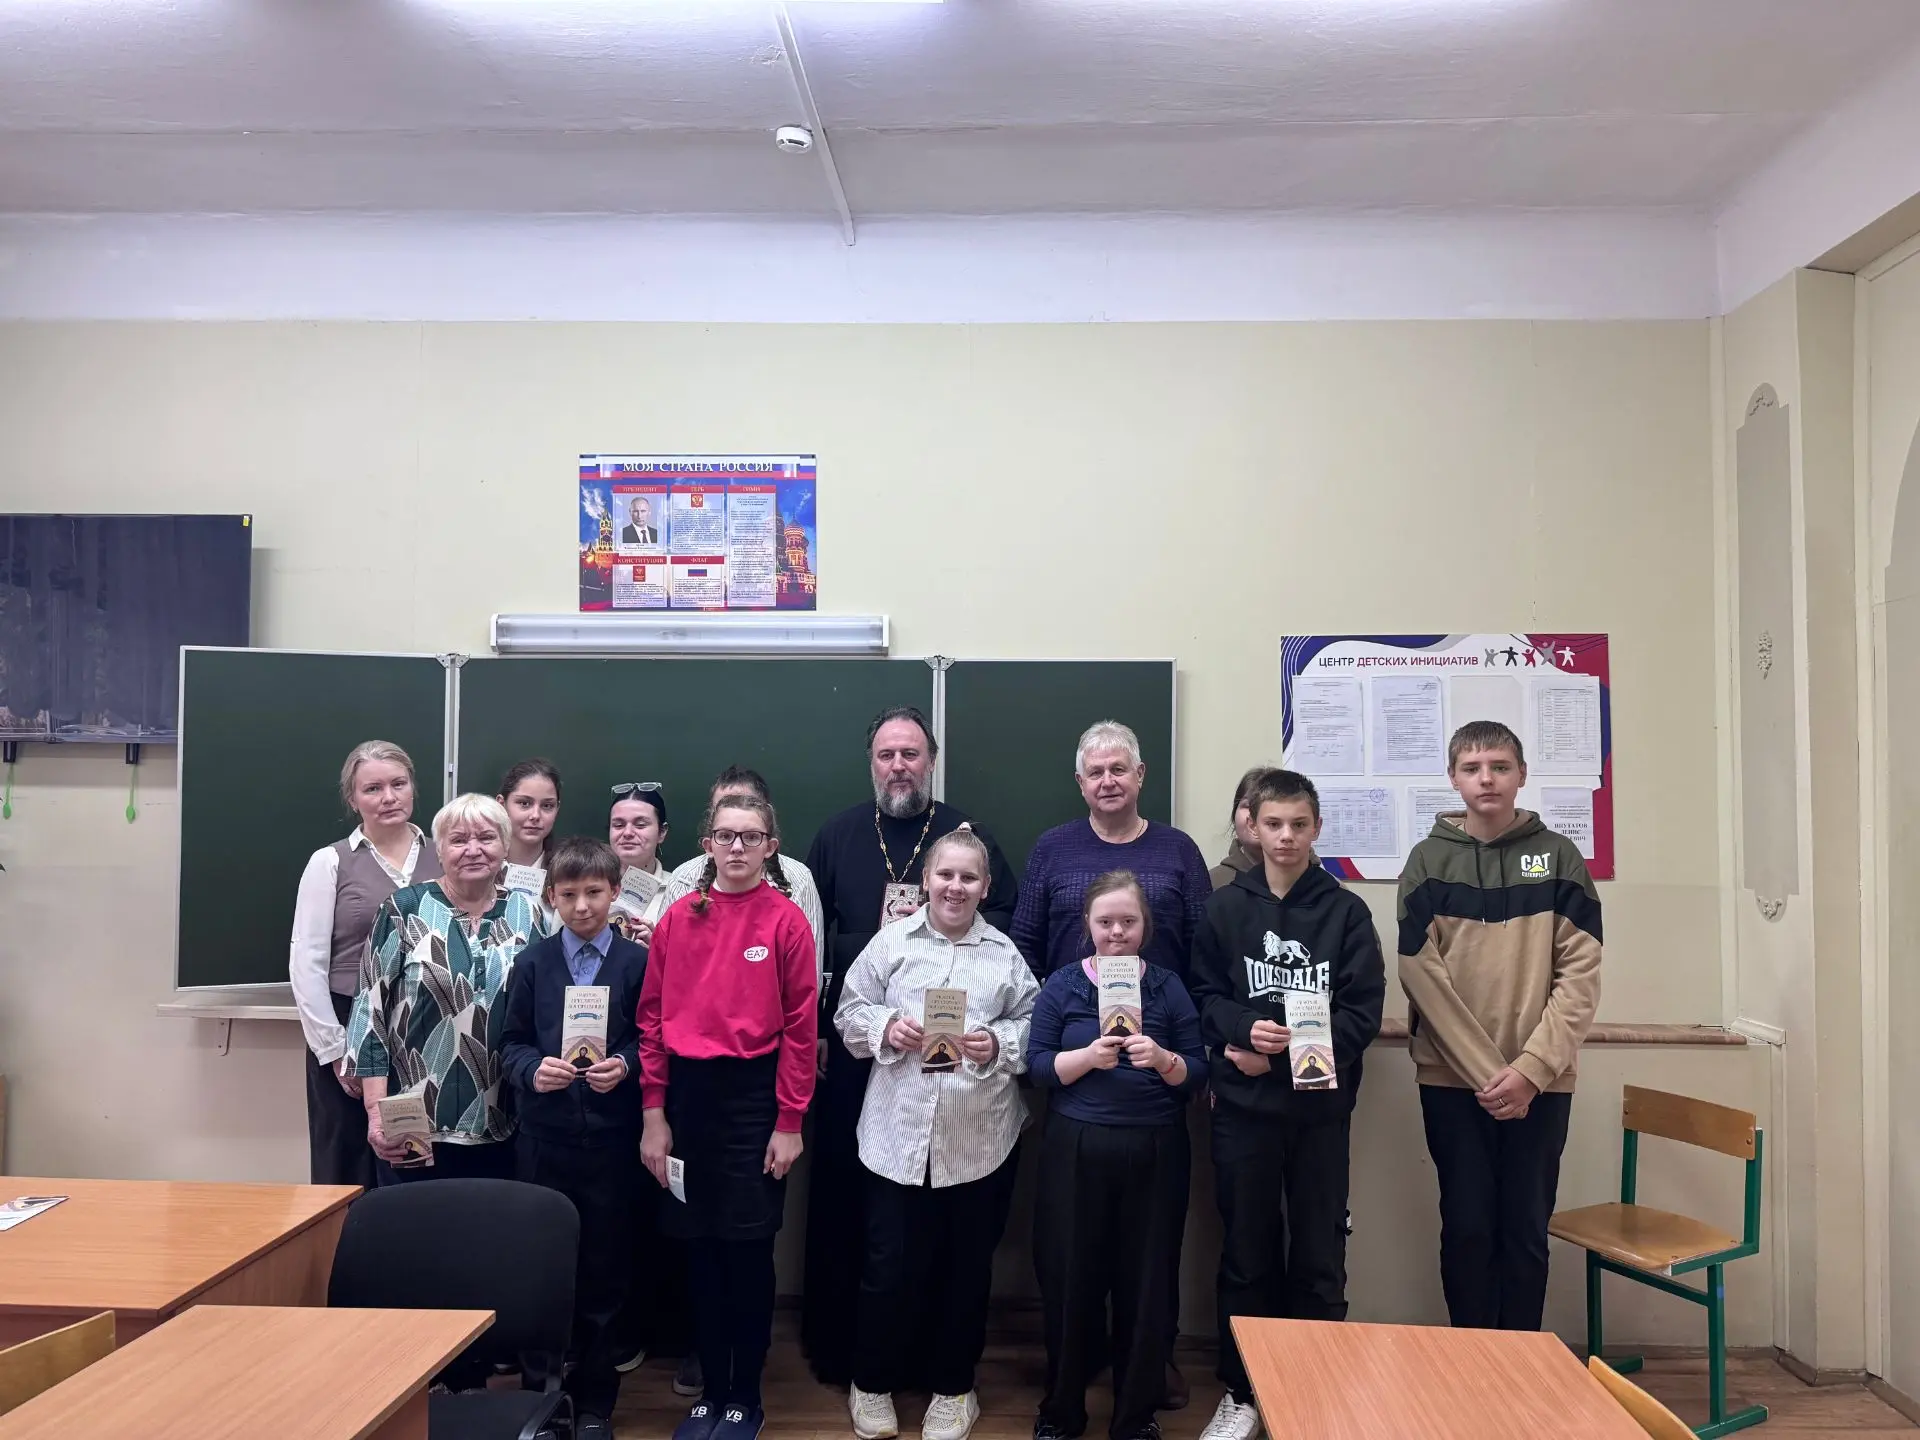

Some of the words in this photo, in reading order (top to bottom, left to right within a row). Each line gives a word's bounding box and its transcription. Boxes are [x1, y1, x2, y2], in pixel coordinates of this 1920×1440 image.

[622, 462, 654, 472] МОЯ
[660, 462, 714, 472] СТРАНА
[719, 462, 774, 472] РОССИЯ
[1318, 657, 1355, 667] ЦЕНТР
[1357, 656, 1408, 667] ДЕТСКИХ
[1410, 656, 1479, 666] ИНИЦИАТИВ
[1520, 852, 1551, 872] CAT
[746, 948, 766, 959] EA7
[1243, 955, 1330, 998] LONSDALE
